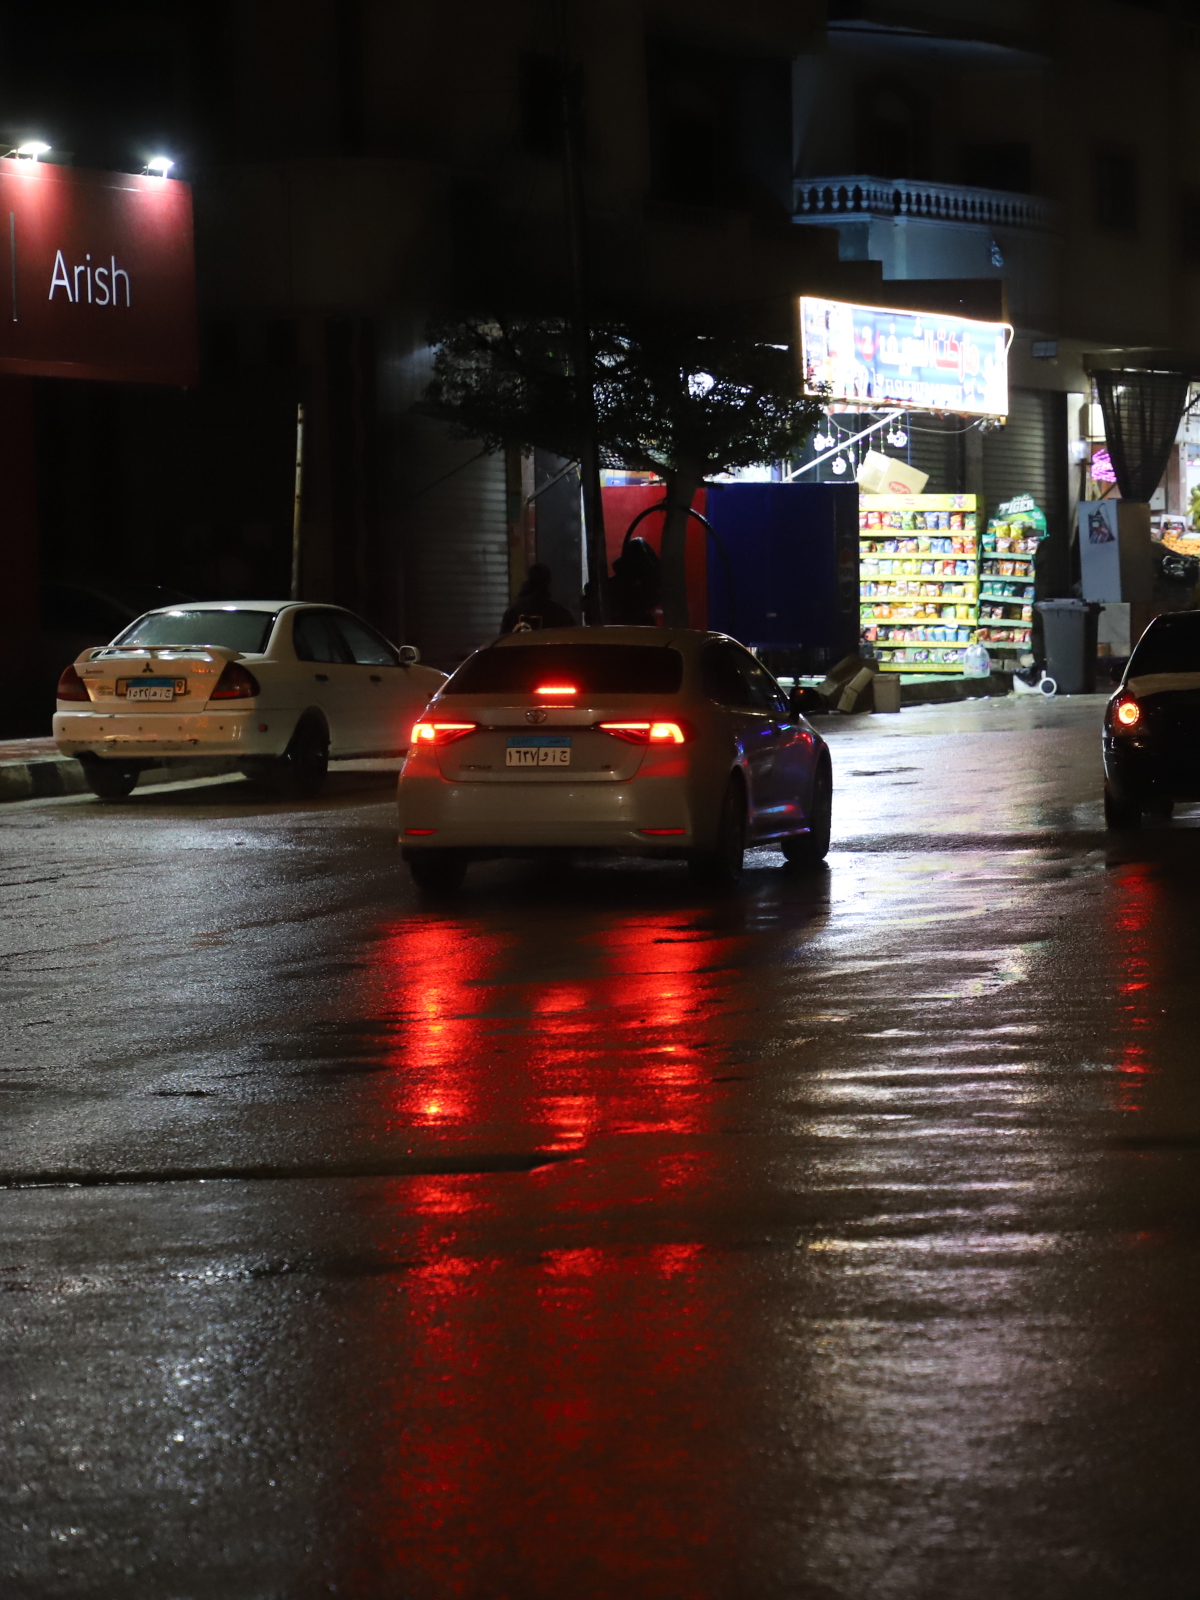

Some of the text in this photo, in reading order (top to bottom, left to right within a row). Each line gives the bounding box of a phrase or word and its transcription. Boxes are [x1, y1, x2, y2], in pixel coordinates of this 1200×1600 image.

[48, 249, 130, 307] Arish
[880, 317, 934, 376] الشريف
[934, 328, 980, 382] ماركت
[999, 499, 1034, 516] TIGER
[508, 750, 538, 763] ١٦٣٧
